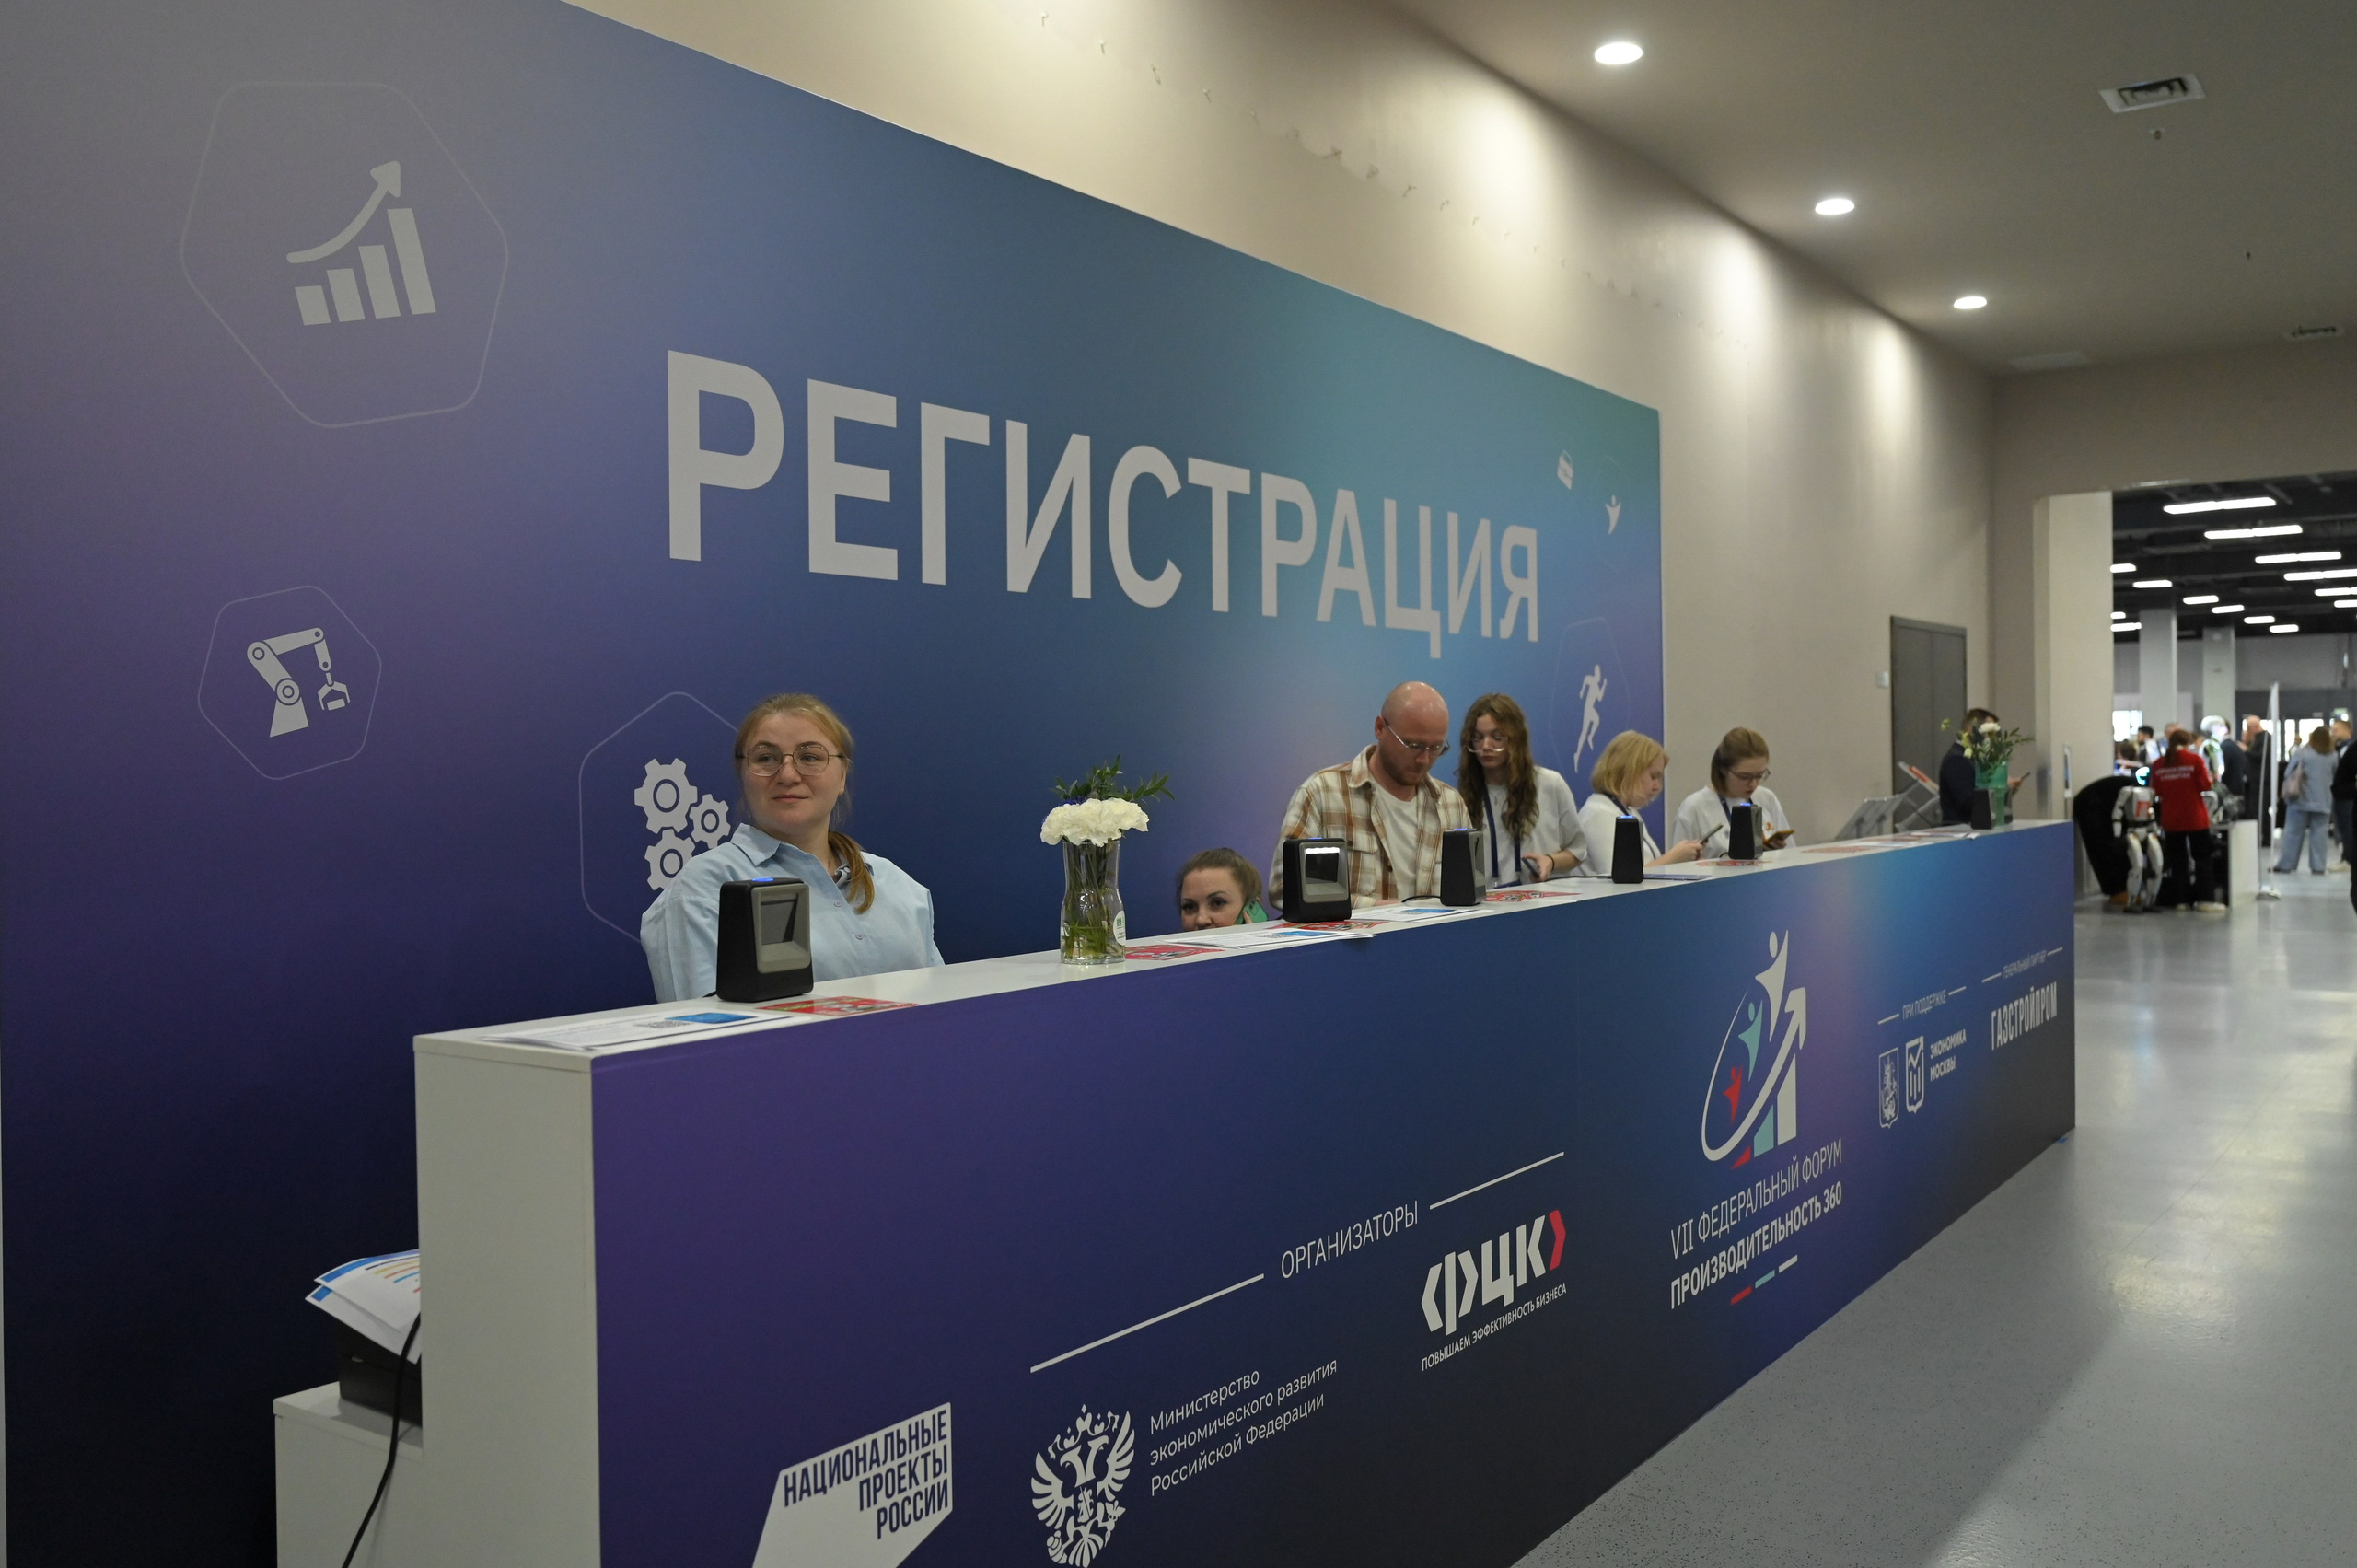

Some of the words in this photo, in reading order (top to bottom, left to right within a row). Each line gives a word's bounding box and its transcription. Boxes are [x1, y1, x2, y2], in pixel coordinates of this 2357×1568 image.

[668, 350, 1538, 659] РЕГИСТРАЦИЯ
[1902, 1002, 1914, 1020] ПРИ
[1915, 989, 1946, 1016] ПОДДЕРЖКЕ
[1930, 1028, 1967, 1059] ЭКОНОМИКА
[1991, 981, 2058, 1051] ГАЗСТРОЙПРОМ
[1930, 1055, 1956, 1082] МОСКВЫ
[1281, 1200, 1418, 1279] ОРГАНИЗАТОРЫ
[1671, 1218, 1694, 1260] VII
[1698, 1155, 1799, 1243] ФЕДЕРАЛЬНЫЙ
[1802, 1138, 1842, 1184] ФОРУМ
[1421, 1214, 1547, 1337] ФЦК
[1671, 1194, 1821, 1310] ПРОИЗВОДИТЕЛЬНОСТЬ
[1823, 1180, 1842, 1214] 360
[1422, 1335, 1471, 1371] ПОВЫШАЕМ
[1472, 1302, 1535, 1344] ЭФФЕКТИВНОСТЬ
[1536, 1283, 1567, 1307] БИЗНЕСА
[1150, 1370, 1260, 1434] Министерство
[1150, 1392, 1273, 1466] экономического
[1277, 1359, 1338, 1406] развития
[784, 1409, 947, 1508] НАЦИОНАЛЬНЫЕ
[859, 1443, 948, 1512] ПРОЕКТЫ
[1151, 1432, 1242, 1496] Российской
[1246, 1393, 1324, 1445] Федерации
[877, 1477, 948, 1539] РОССИИ
